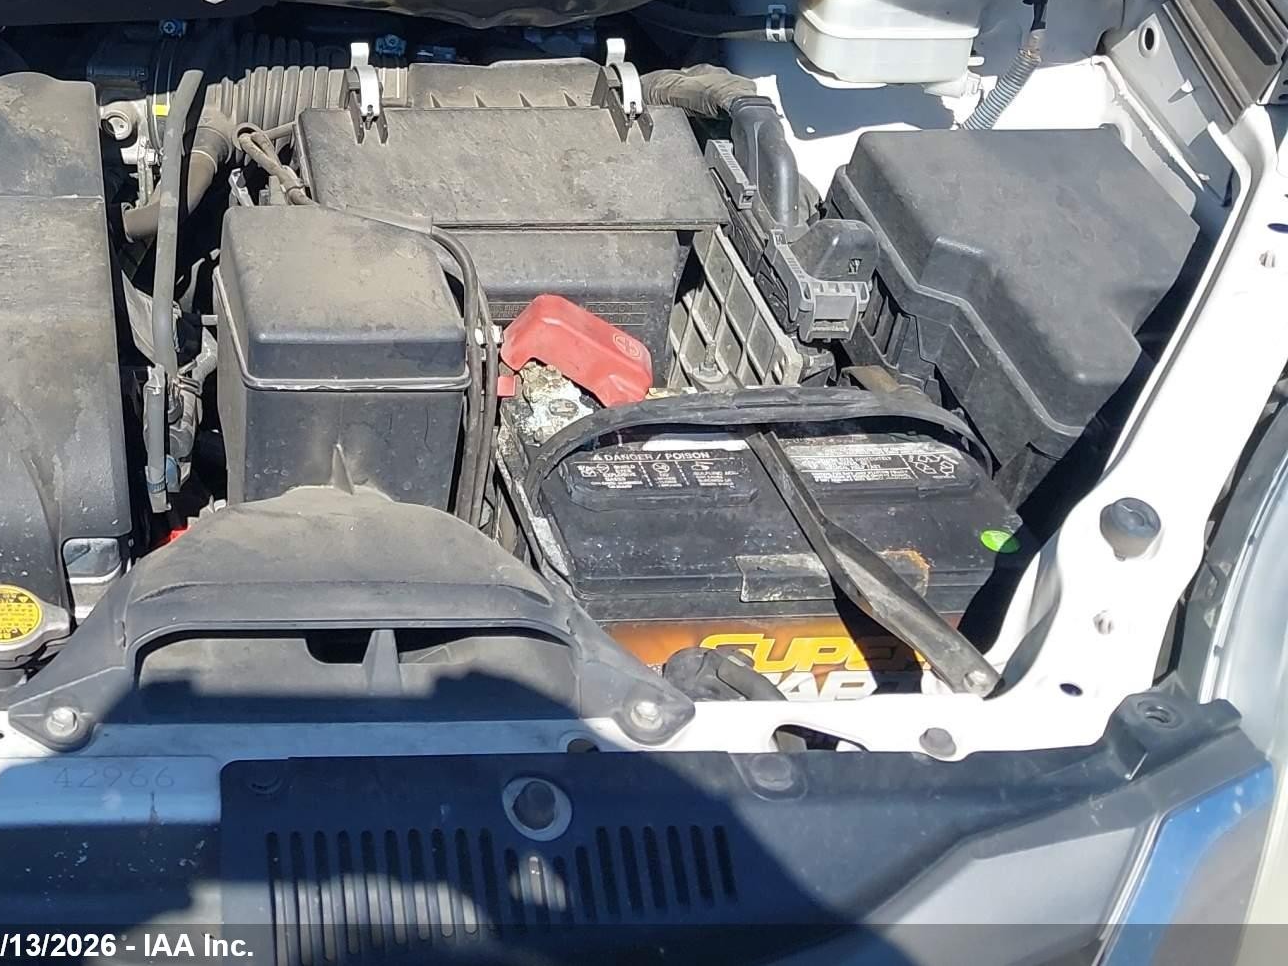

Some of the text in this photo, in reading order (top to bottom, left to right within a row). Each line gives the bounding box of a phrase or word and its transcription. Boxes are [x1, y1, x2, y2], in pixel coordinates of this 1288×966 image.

[603, 452, 653, 462] DANGER
[664, 451, 711, 461] POISON
[52, 765, 176, 788] 42966
